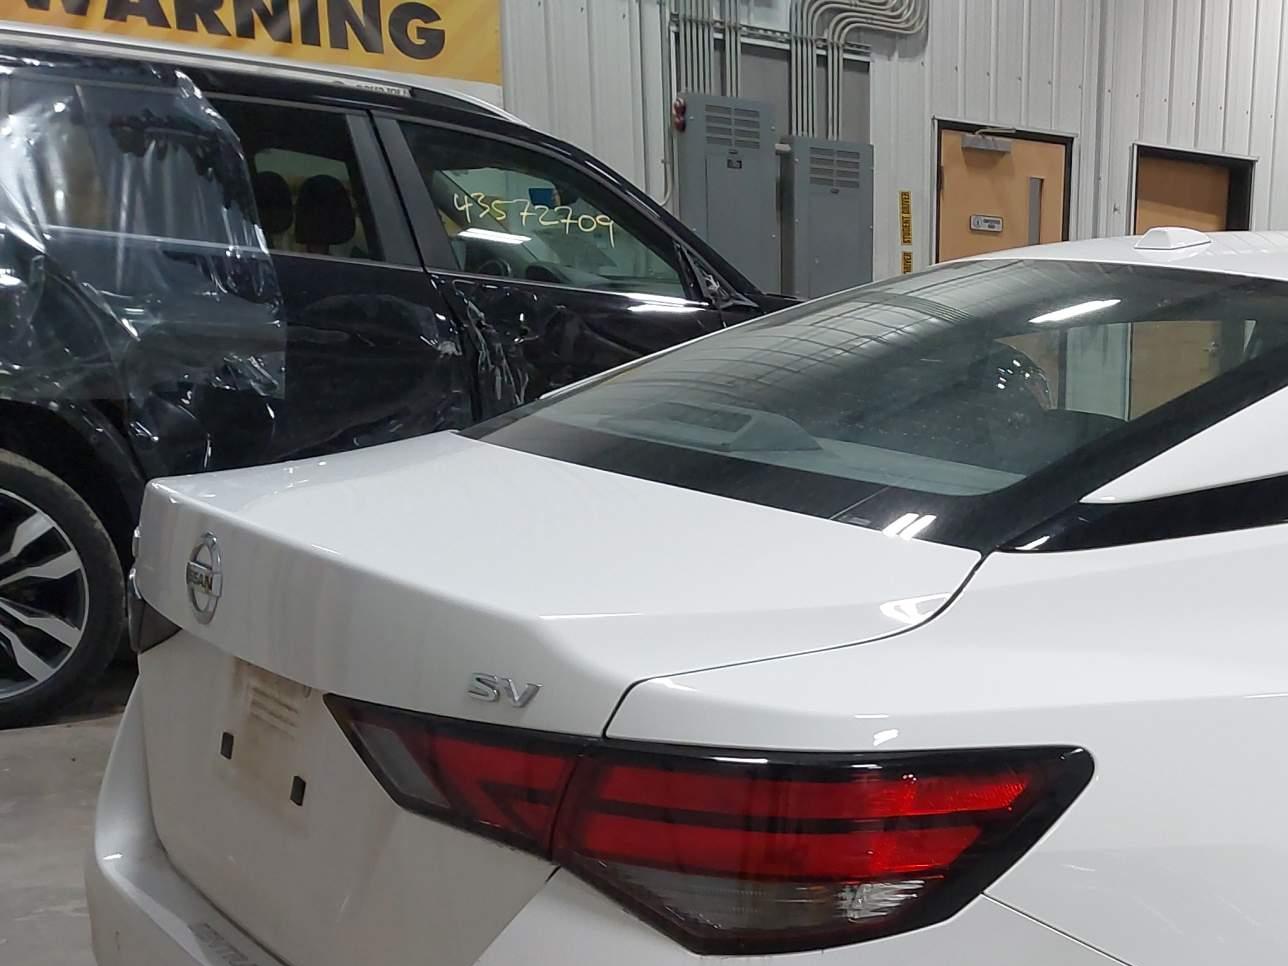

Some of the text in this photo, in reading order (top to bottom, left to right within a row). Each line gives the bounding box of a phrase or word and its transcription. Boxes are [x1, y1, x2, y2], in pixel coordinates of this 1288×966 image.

[22, 0, 446, 61] ARNING
[453, 192, 615, 248] 43572709
[466, 672, 543, 708] SV
